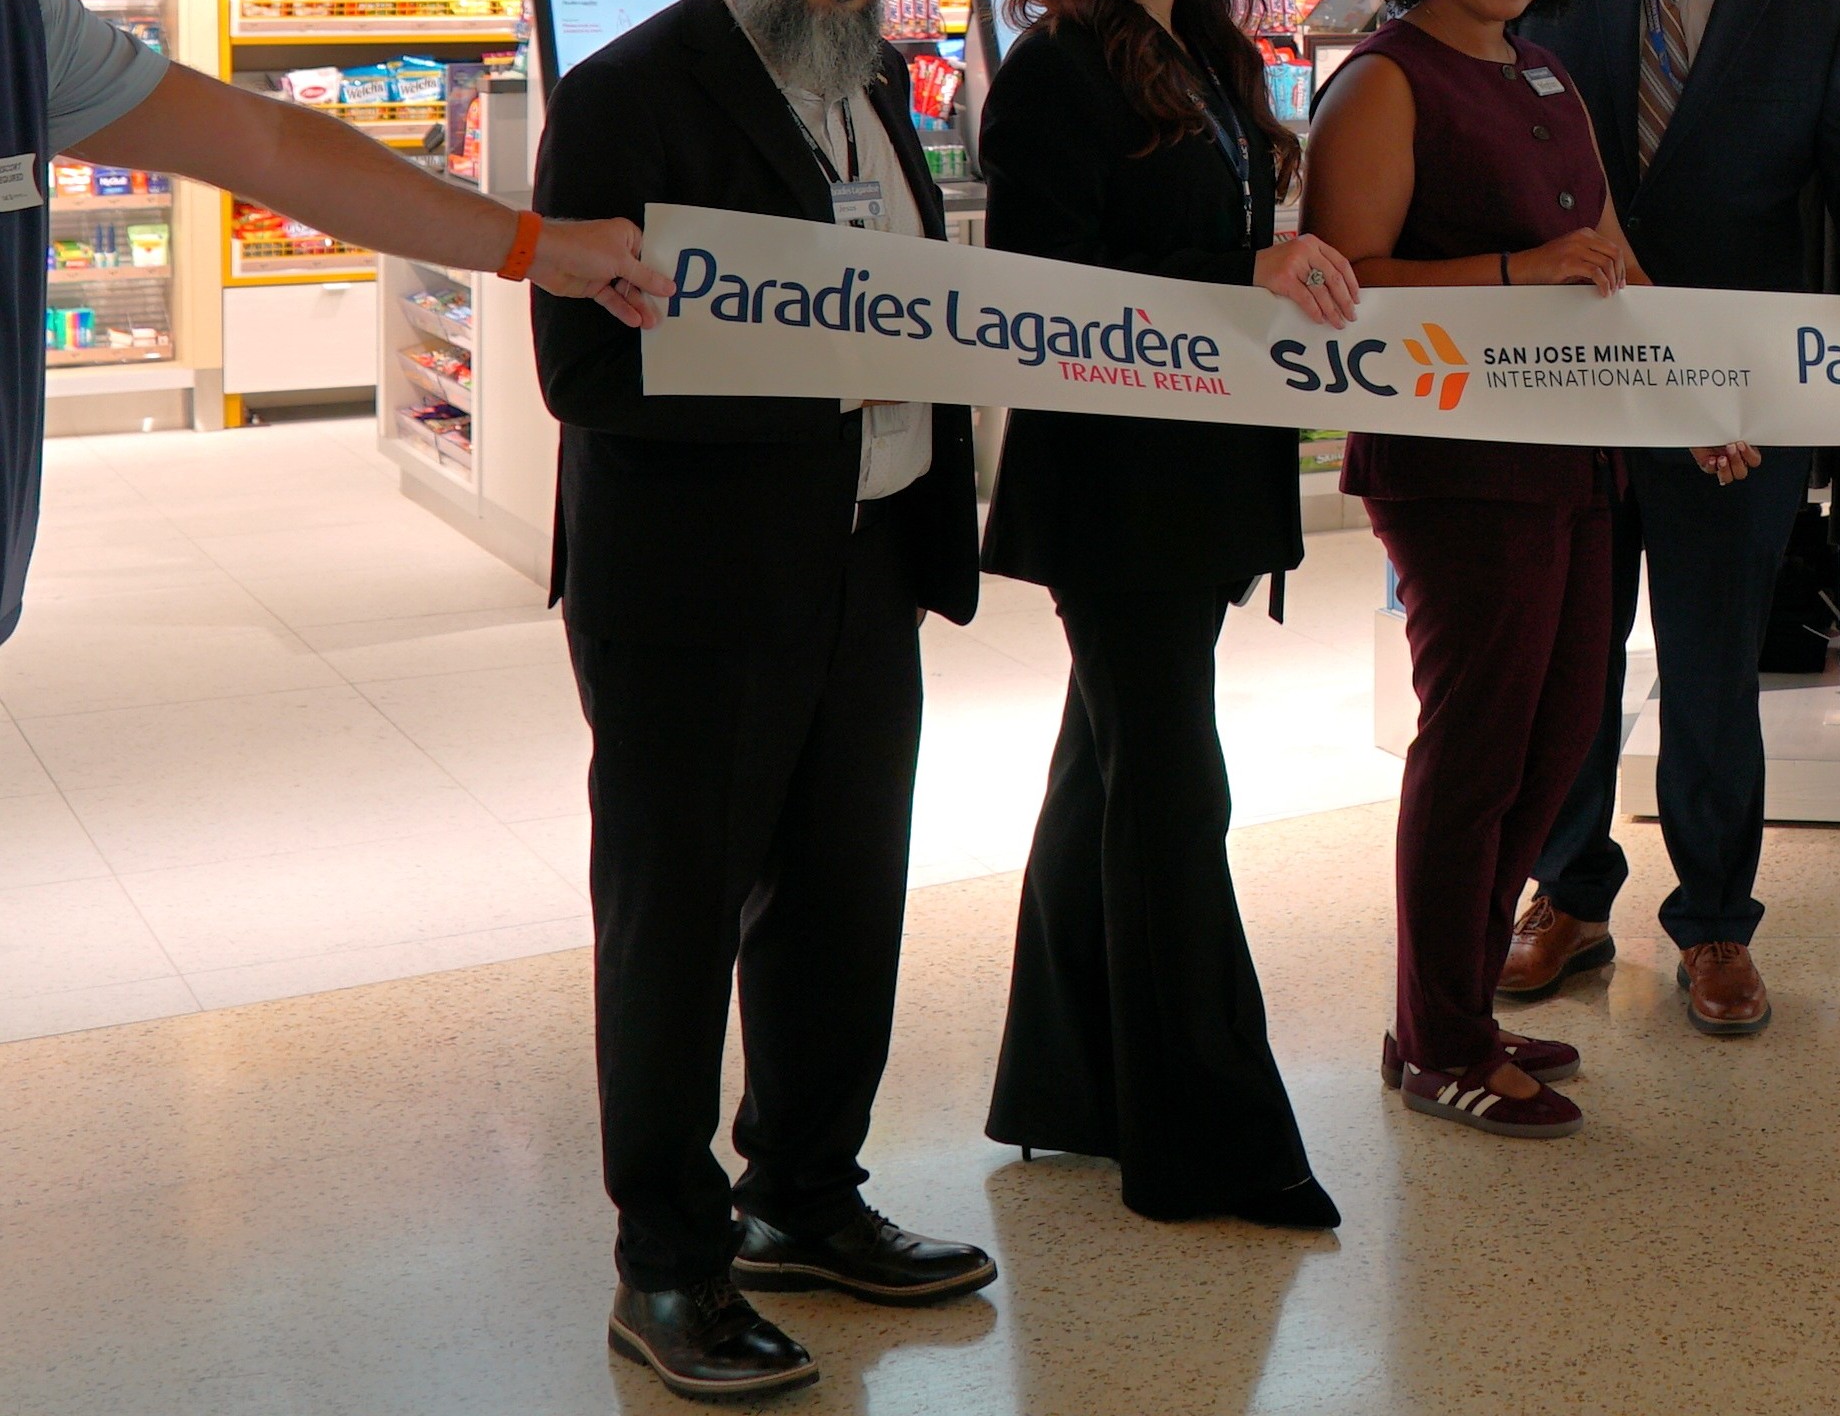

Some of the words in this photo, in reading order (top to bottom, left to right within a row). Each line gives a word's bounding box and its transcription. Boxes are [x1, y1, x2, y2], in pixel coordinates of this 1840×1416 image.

[667, 248, 933, 340] Paradies
[946, 290, 1220, 372] Lagardère
[1270, 338, 1398, 397] SJC
[1484, 347, 1529, 364] SAN
[1534, 346, 1586, 364] JOSE
[1594, 344, 1675, 363] MINETA
[1058, 360, 1146, 388] TRAVEL
[1153, 371, 1232, 397] RETAIL
[1487, 368, 1658, 388] INTERNATIONAL
[1665, 368, 1752, 388] AIRPORT
